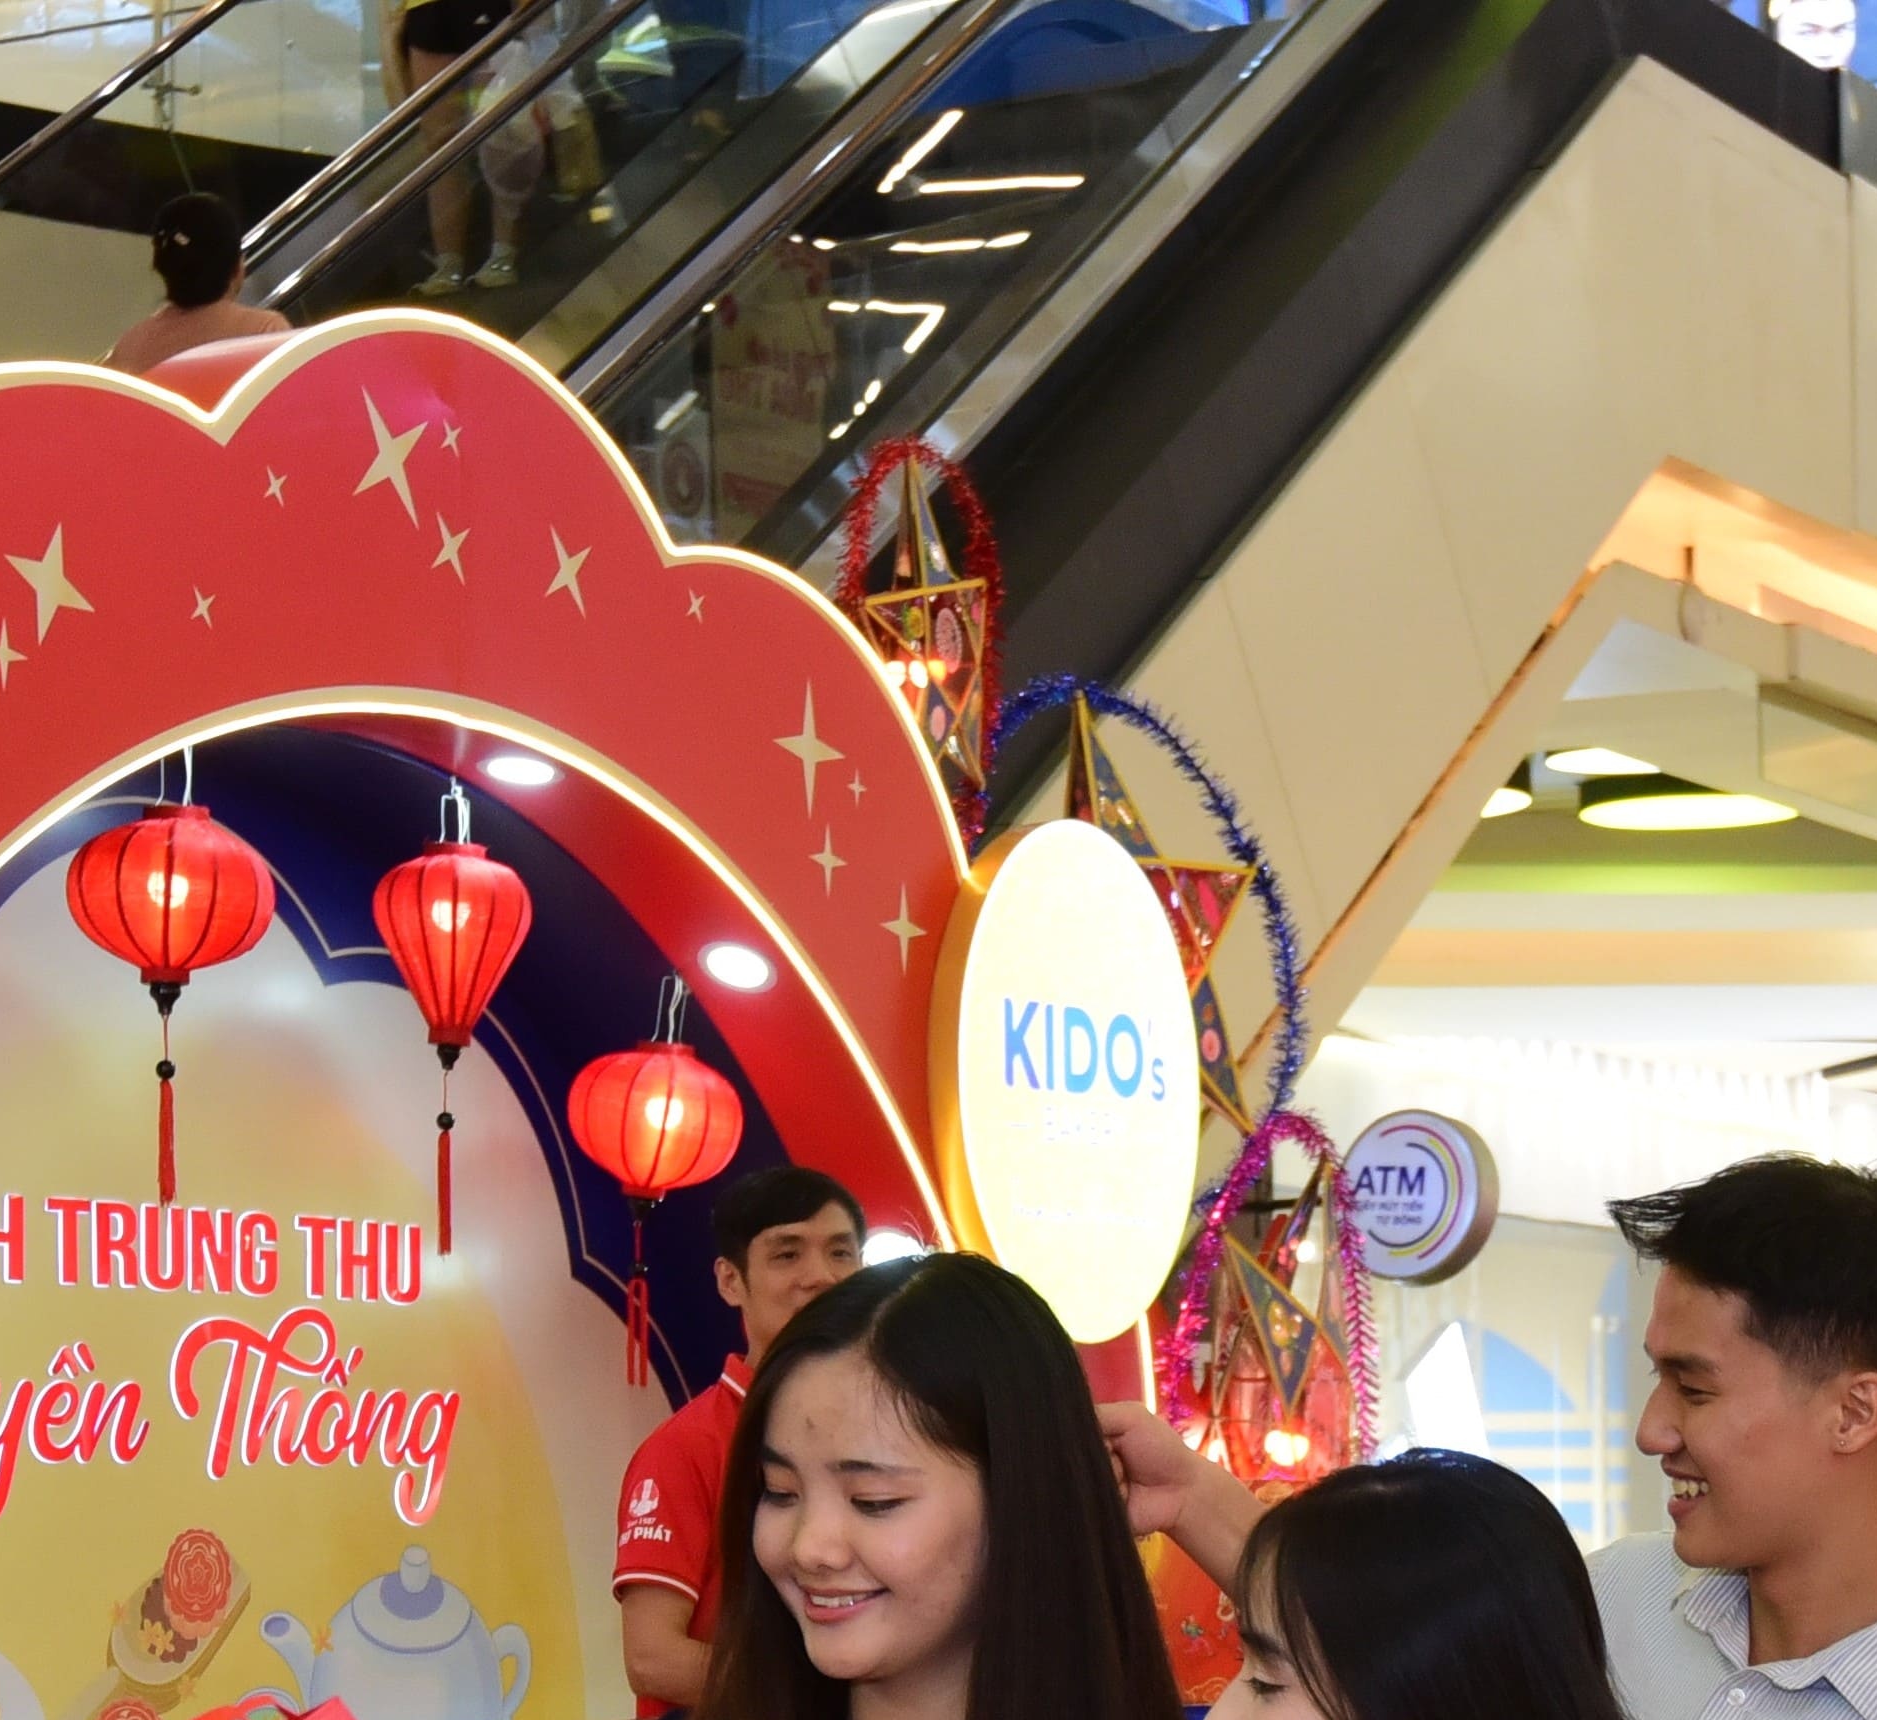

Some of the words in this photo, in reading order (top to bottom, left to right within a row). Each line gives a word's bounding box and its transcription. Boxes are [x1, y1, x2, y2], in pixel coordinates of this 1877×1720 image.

[1003, 997, 1166, 1102] KIDO's
[1351, 1165, 1426, 1197] ATM
[45, 1195, 279, 1298] TRUNG
[295, 1213, 424, 1306] THU
[170, 1304, 462, 1528] Thống
[633, 1524, 673, 1543] PHÁT
